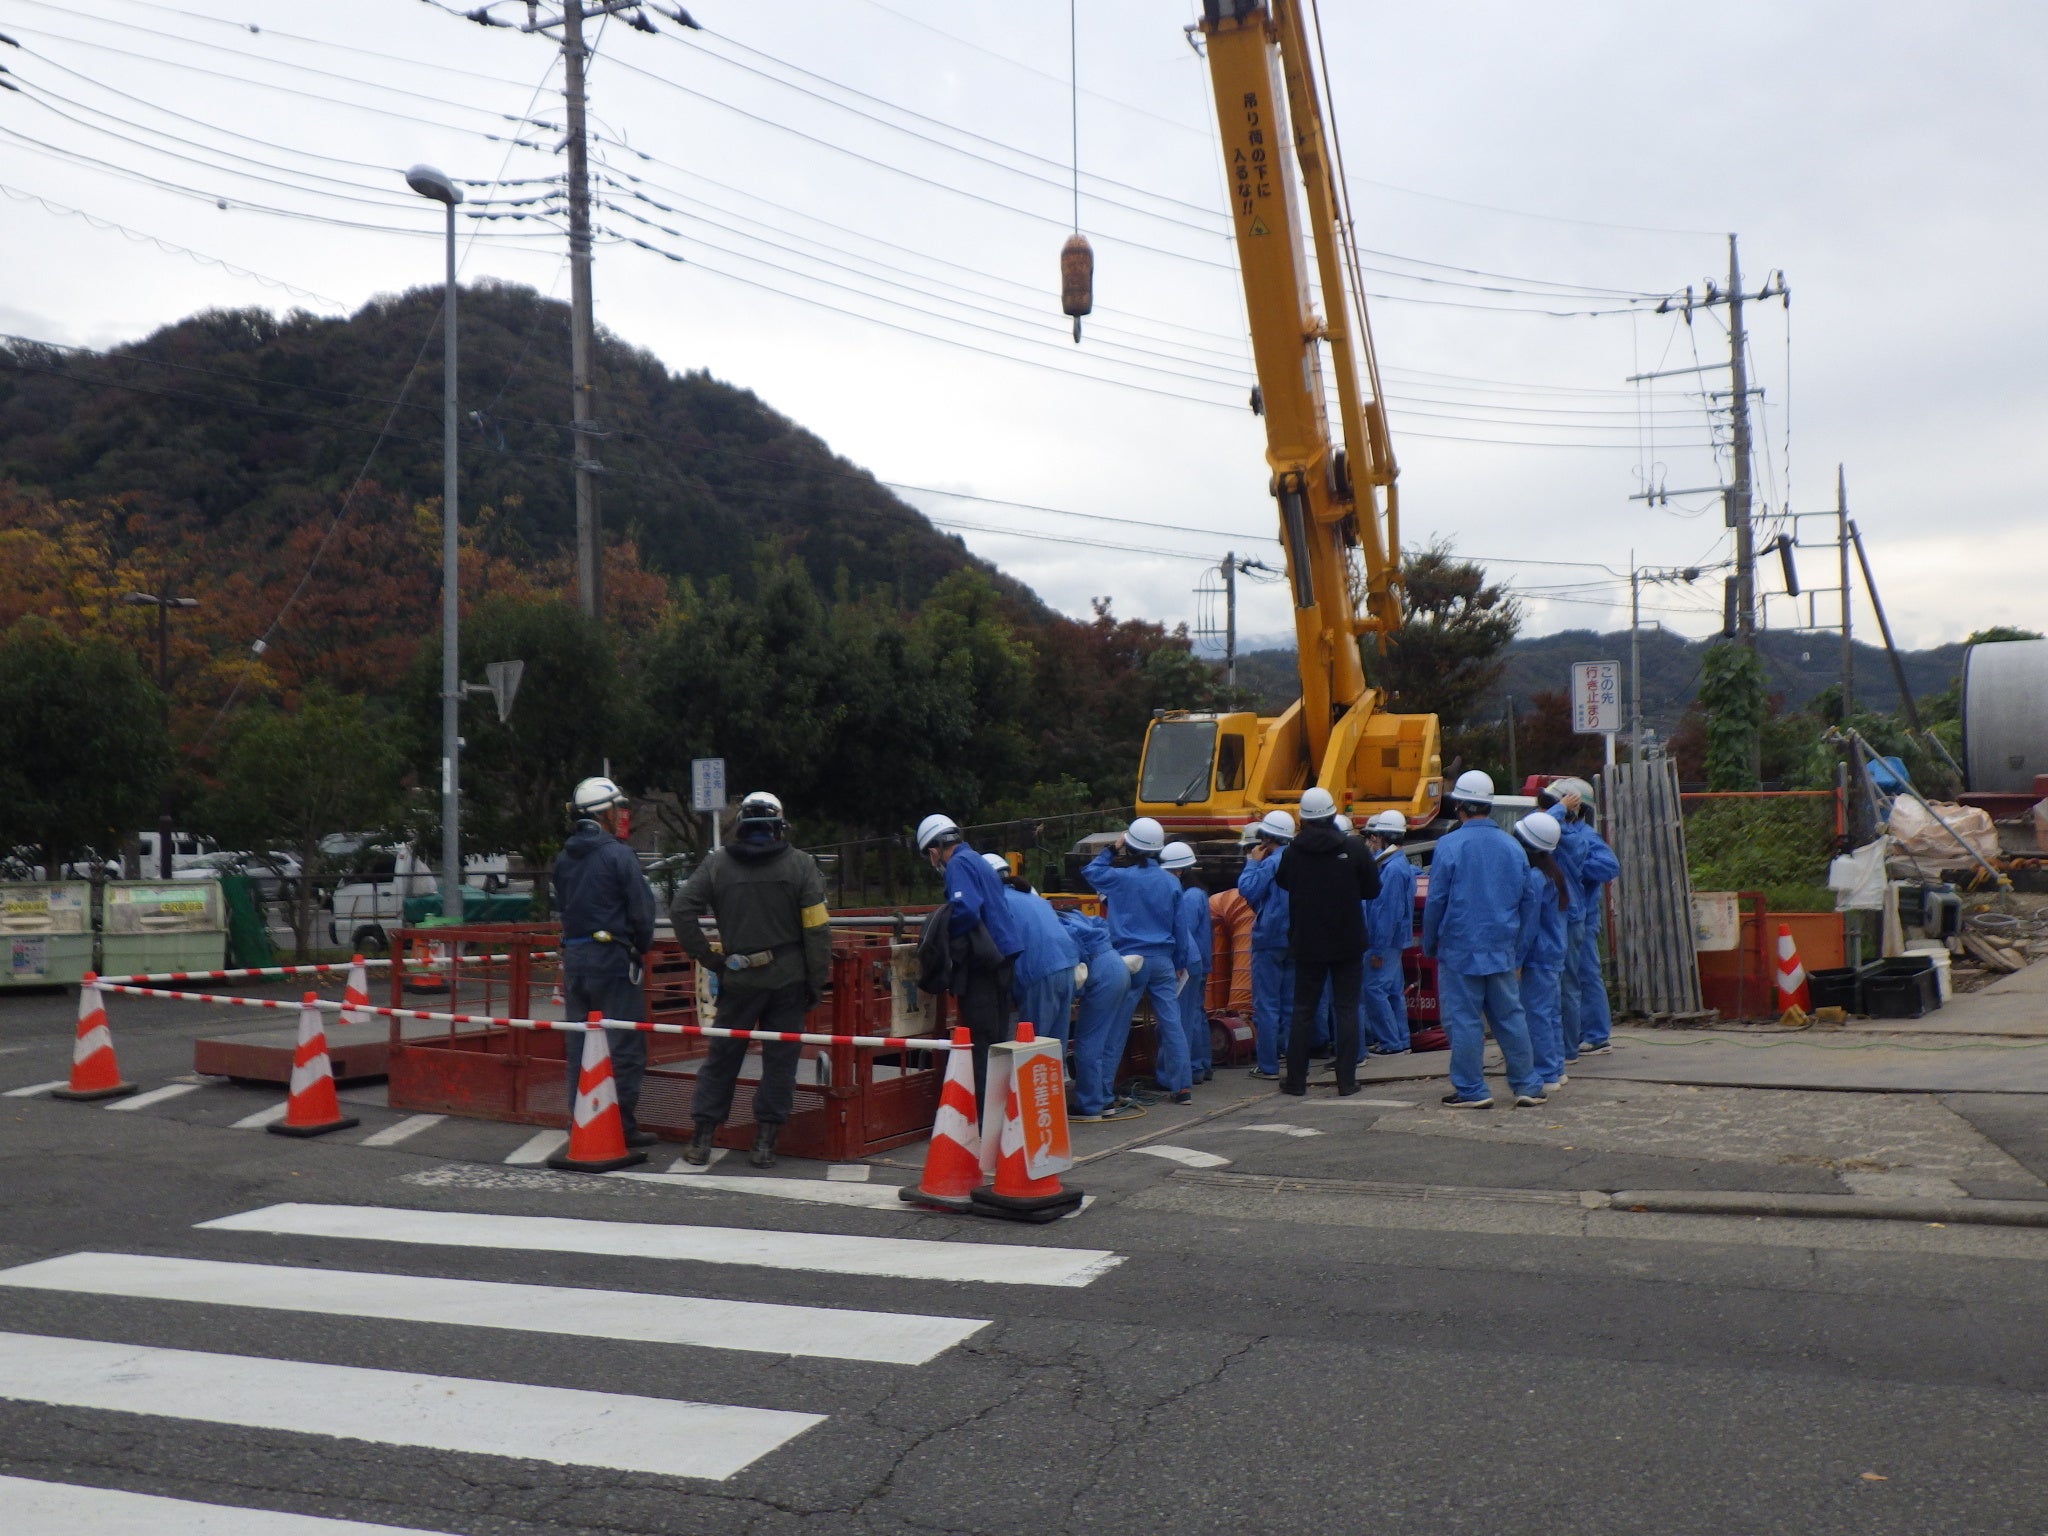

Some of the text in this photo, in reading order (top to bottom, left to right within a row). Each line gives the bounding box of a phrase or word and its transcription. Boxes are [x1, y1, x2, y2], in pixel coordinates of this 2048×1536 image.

[1243, 92, 1271, 199] 吊り荷の下に
[1586, 666, 1600, 728] 行き止まり
[1601, 666, 1615, 704] この先
